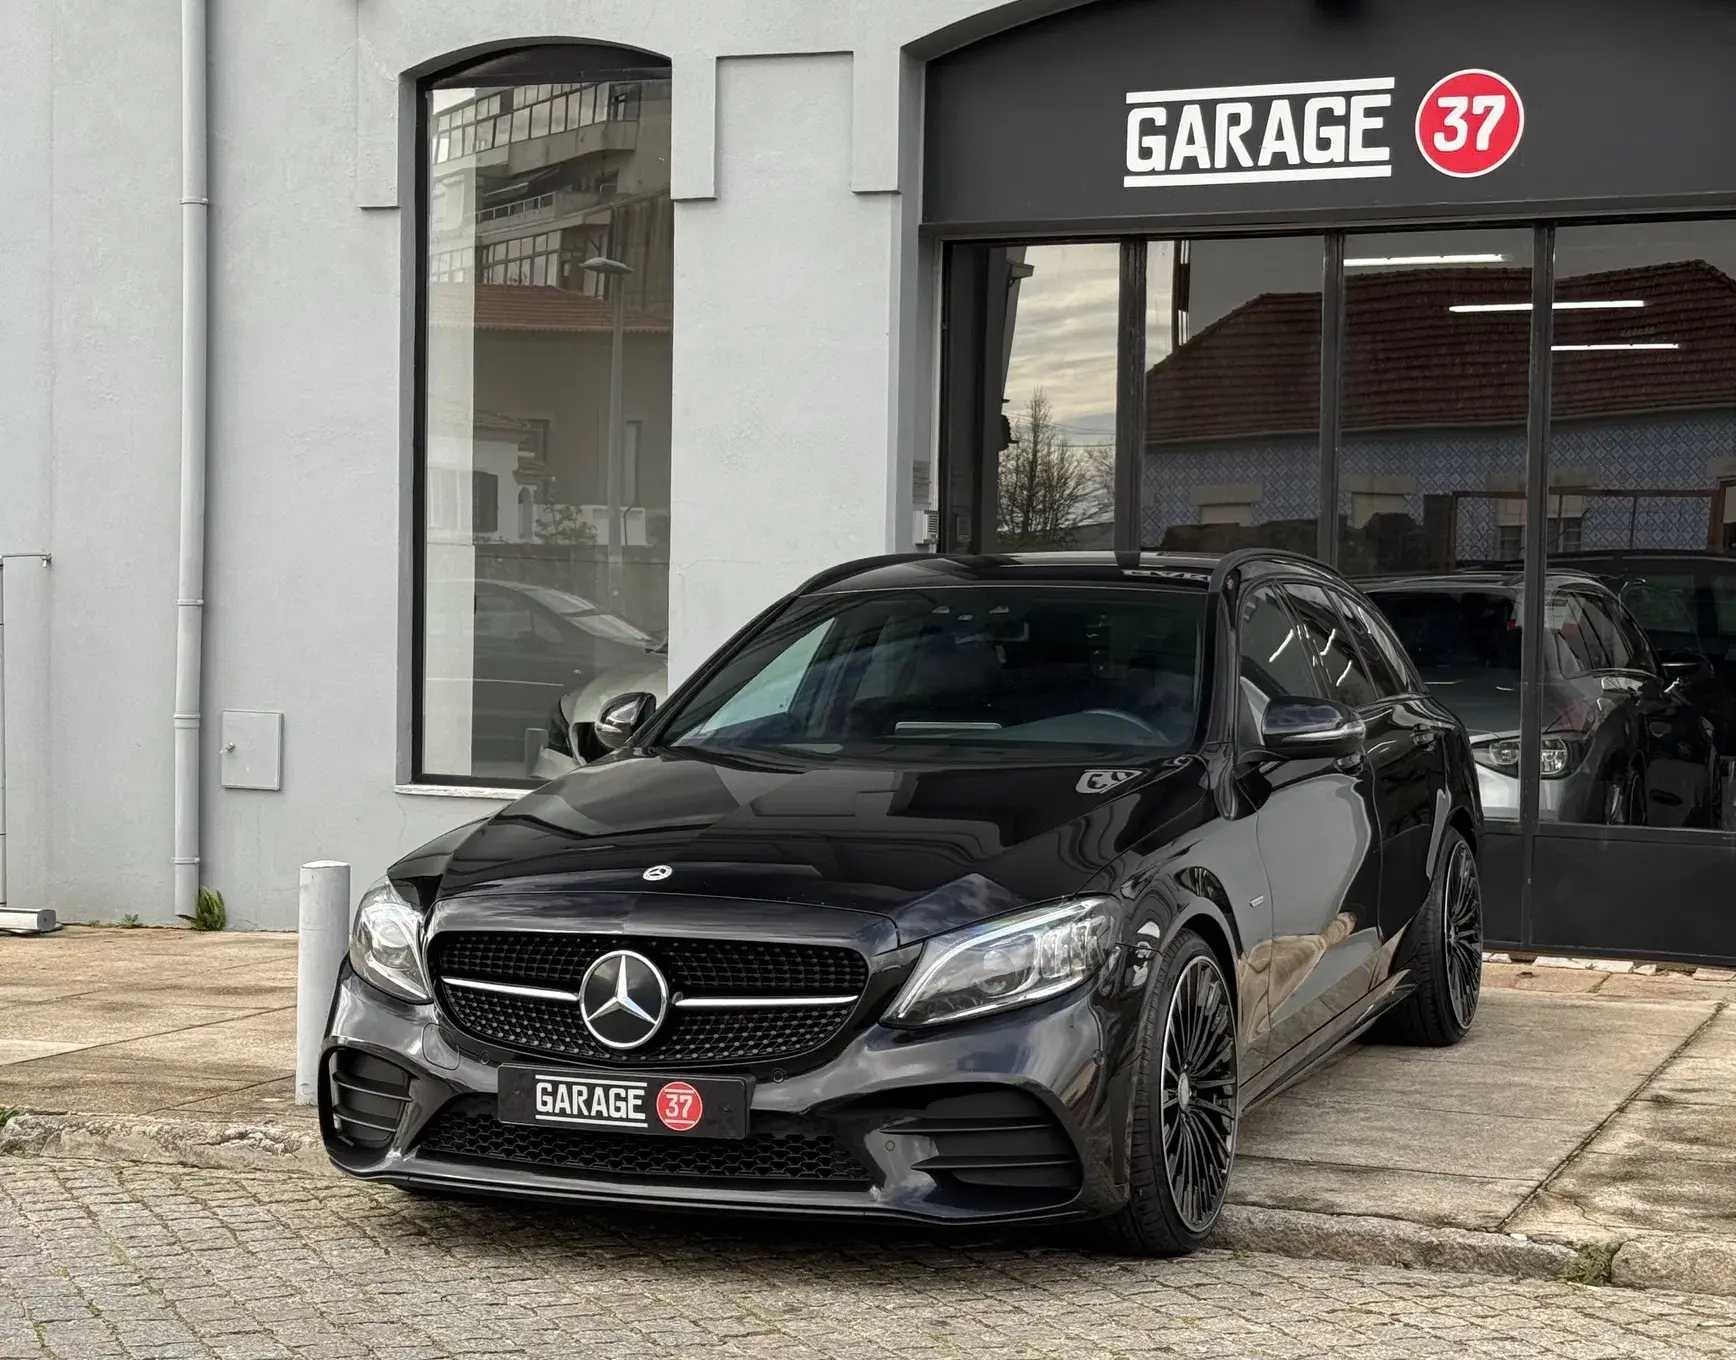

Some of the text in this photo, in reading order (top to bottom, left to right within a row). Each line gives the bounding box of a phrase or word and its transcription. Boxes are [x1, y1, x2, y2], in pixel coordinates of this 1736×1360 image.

[1126, 94, 1506, 173] GARAGE 37
[535, 1082, 693, 1120] GARAGE 37
